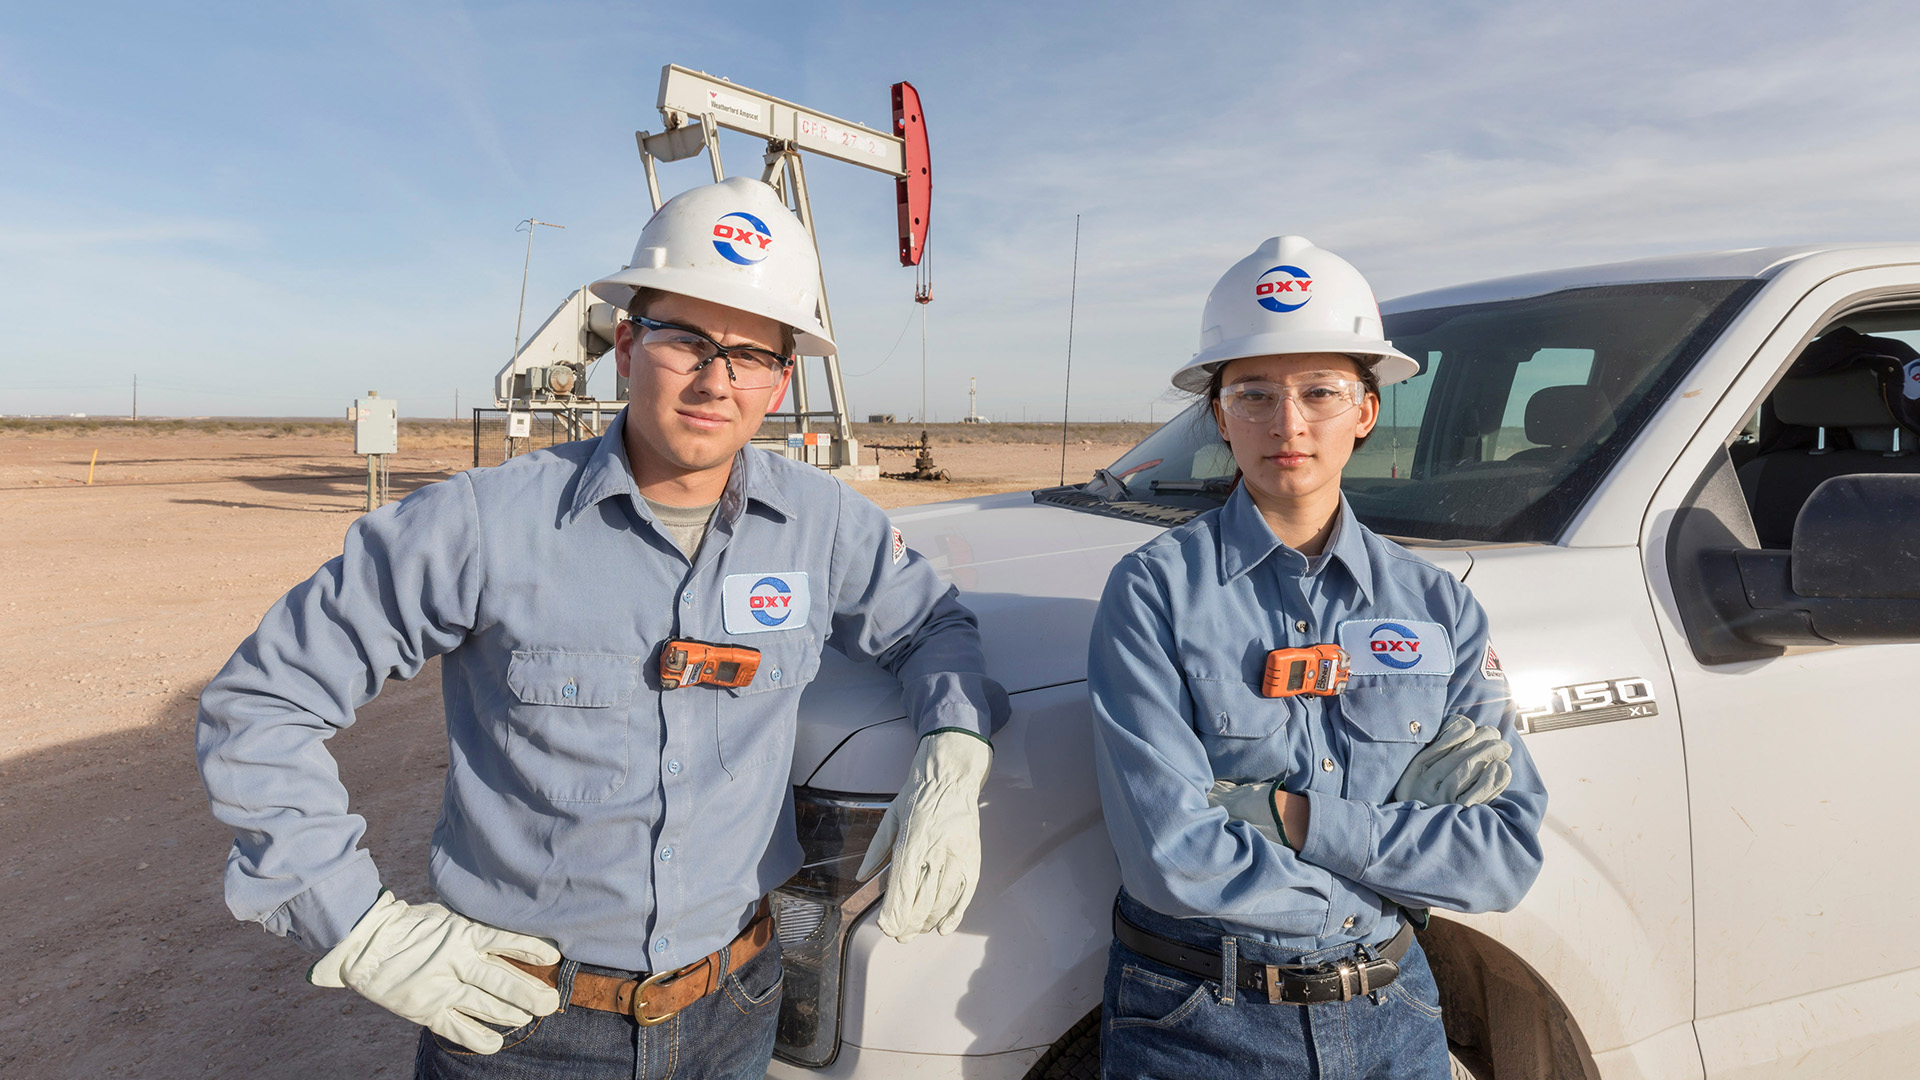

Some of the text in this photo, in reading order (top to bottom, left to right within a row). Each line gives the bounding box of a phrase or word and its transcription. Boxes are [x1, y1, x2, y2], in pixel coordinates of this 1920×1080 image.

[711, 100, 739, 115] Weatherford
[713, 224, 773, 250] OXY
[1256, 280, 1313, 296] OXY
[750, 596, 792, 608] OXY
[1370, 640, 1421, 652] OXY
[1629, 706, 1653, 717] XL
